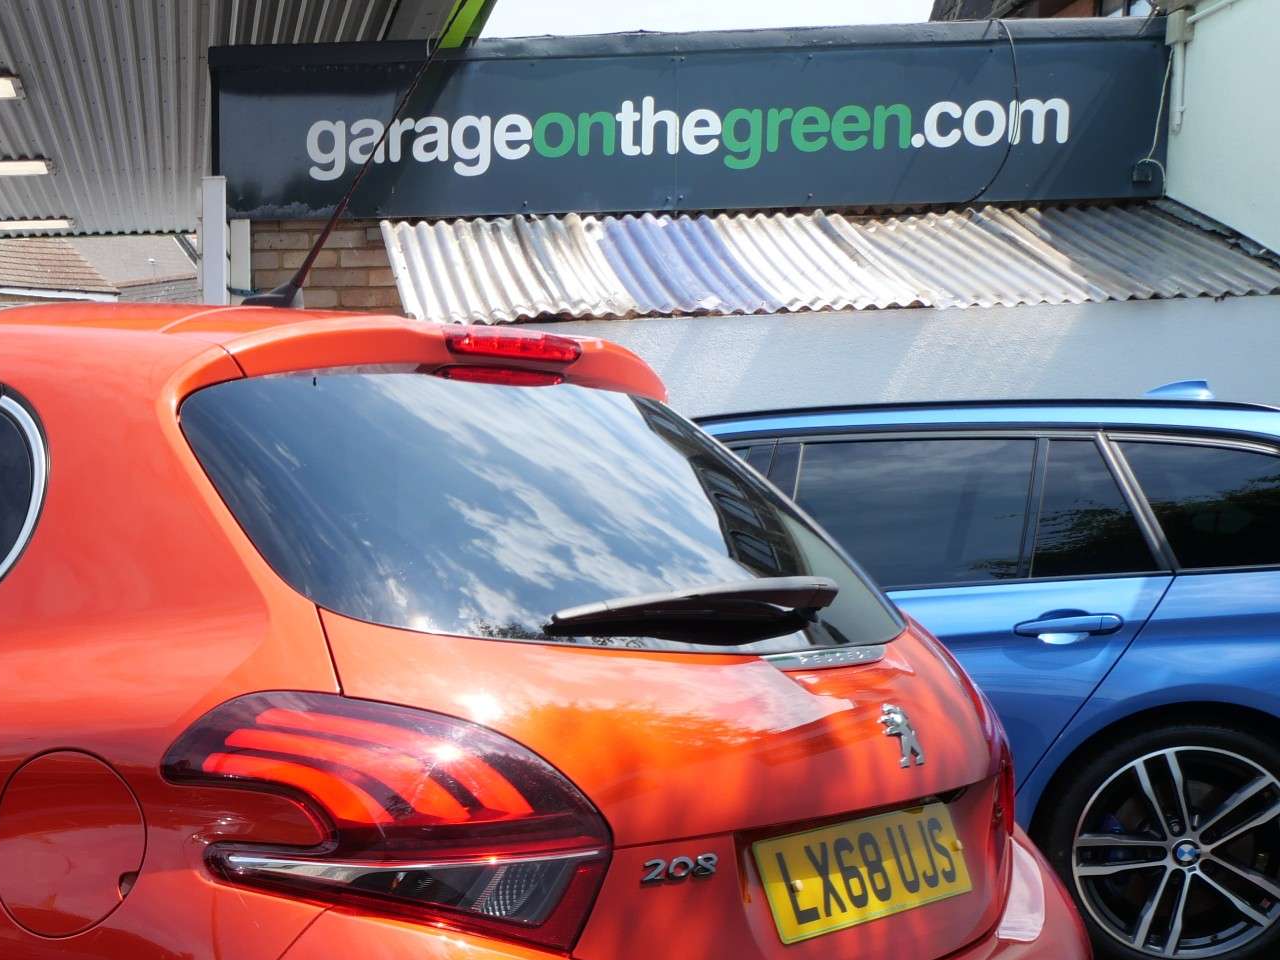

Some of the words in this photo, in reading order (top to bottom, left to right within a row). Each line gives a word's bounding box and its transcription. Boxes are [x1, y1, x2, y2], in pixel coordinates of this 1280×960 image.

[306, 96, 1069, 181] garageonthegreen.com
[642, 853, 718, 883] 208
[776, 831, 892, 925] LX68
[886, 817, 956, 893] UJS
